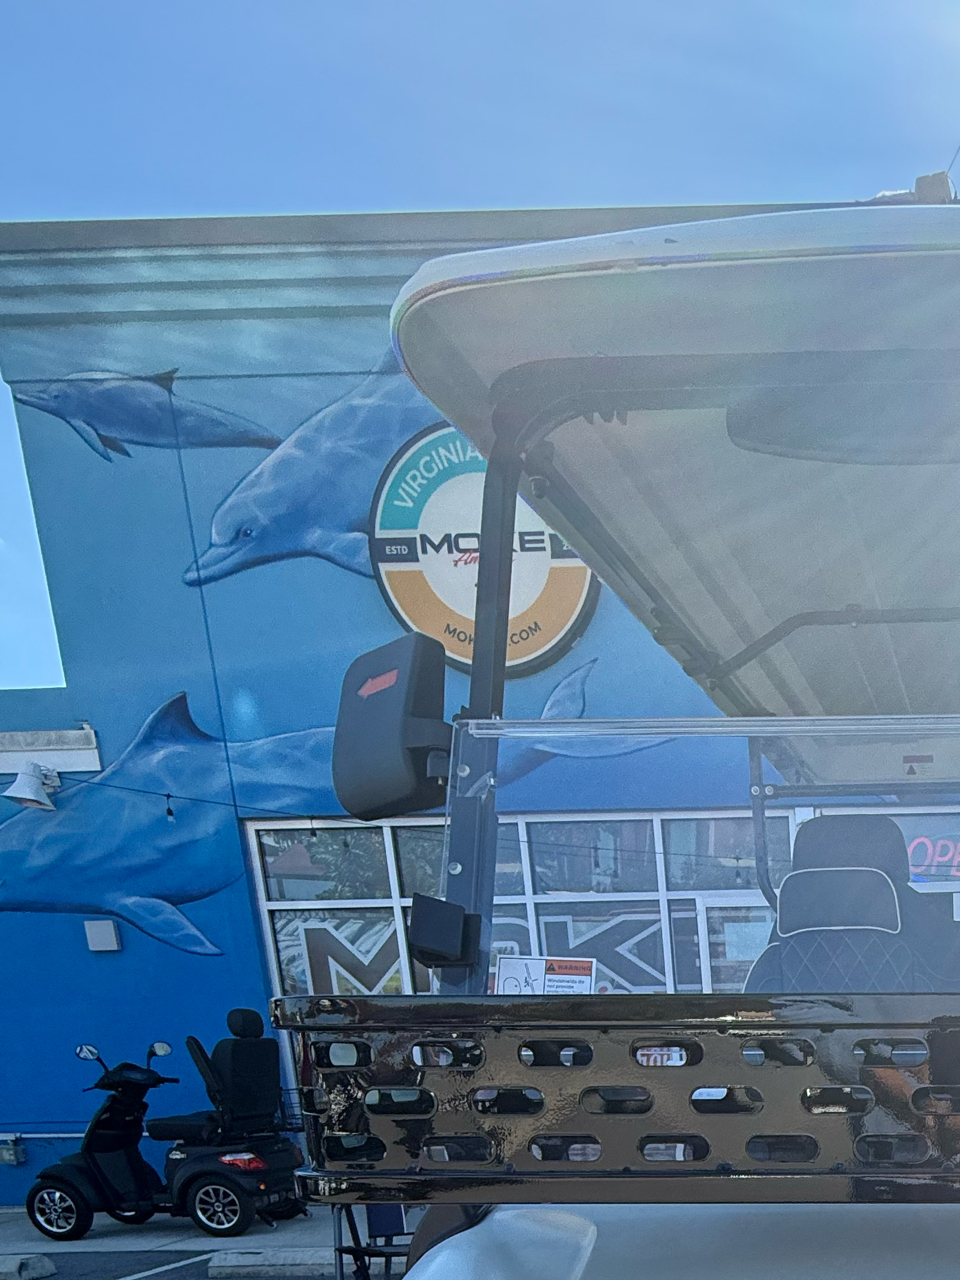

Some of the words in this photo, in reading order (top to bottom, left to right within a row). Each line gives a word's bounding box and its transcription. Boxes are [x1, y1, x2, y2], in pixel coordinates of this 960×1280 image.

[393, 440, 484, 508] VIRGINIA
[385, 545, 409, 555] ESTD
[420, 531, 547, 555] MOE
